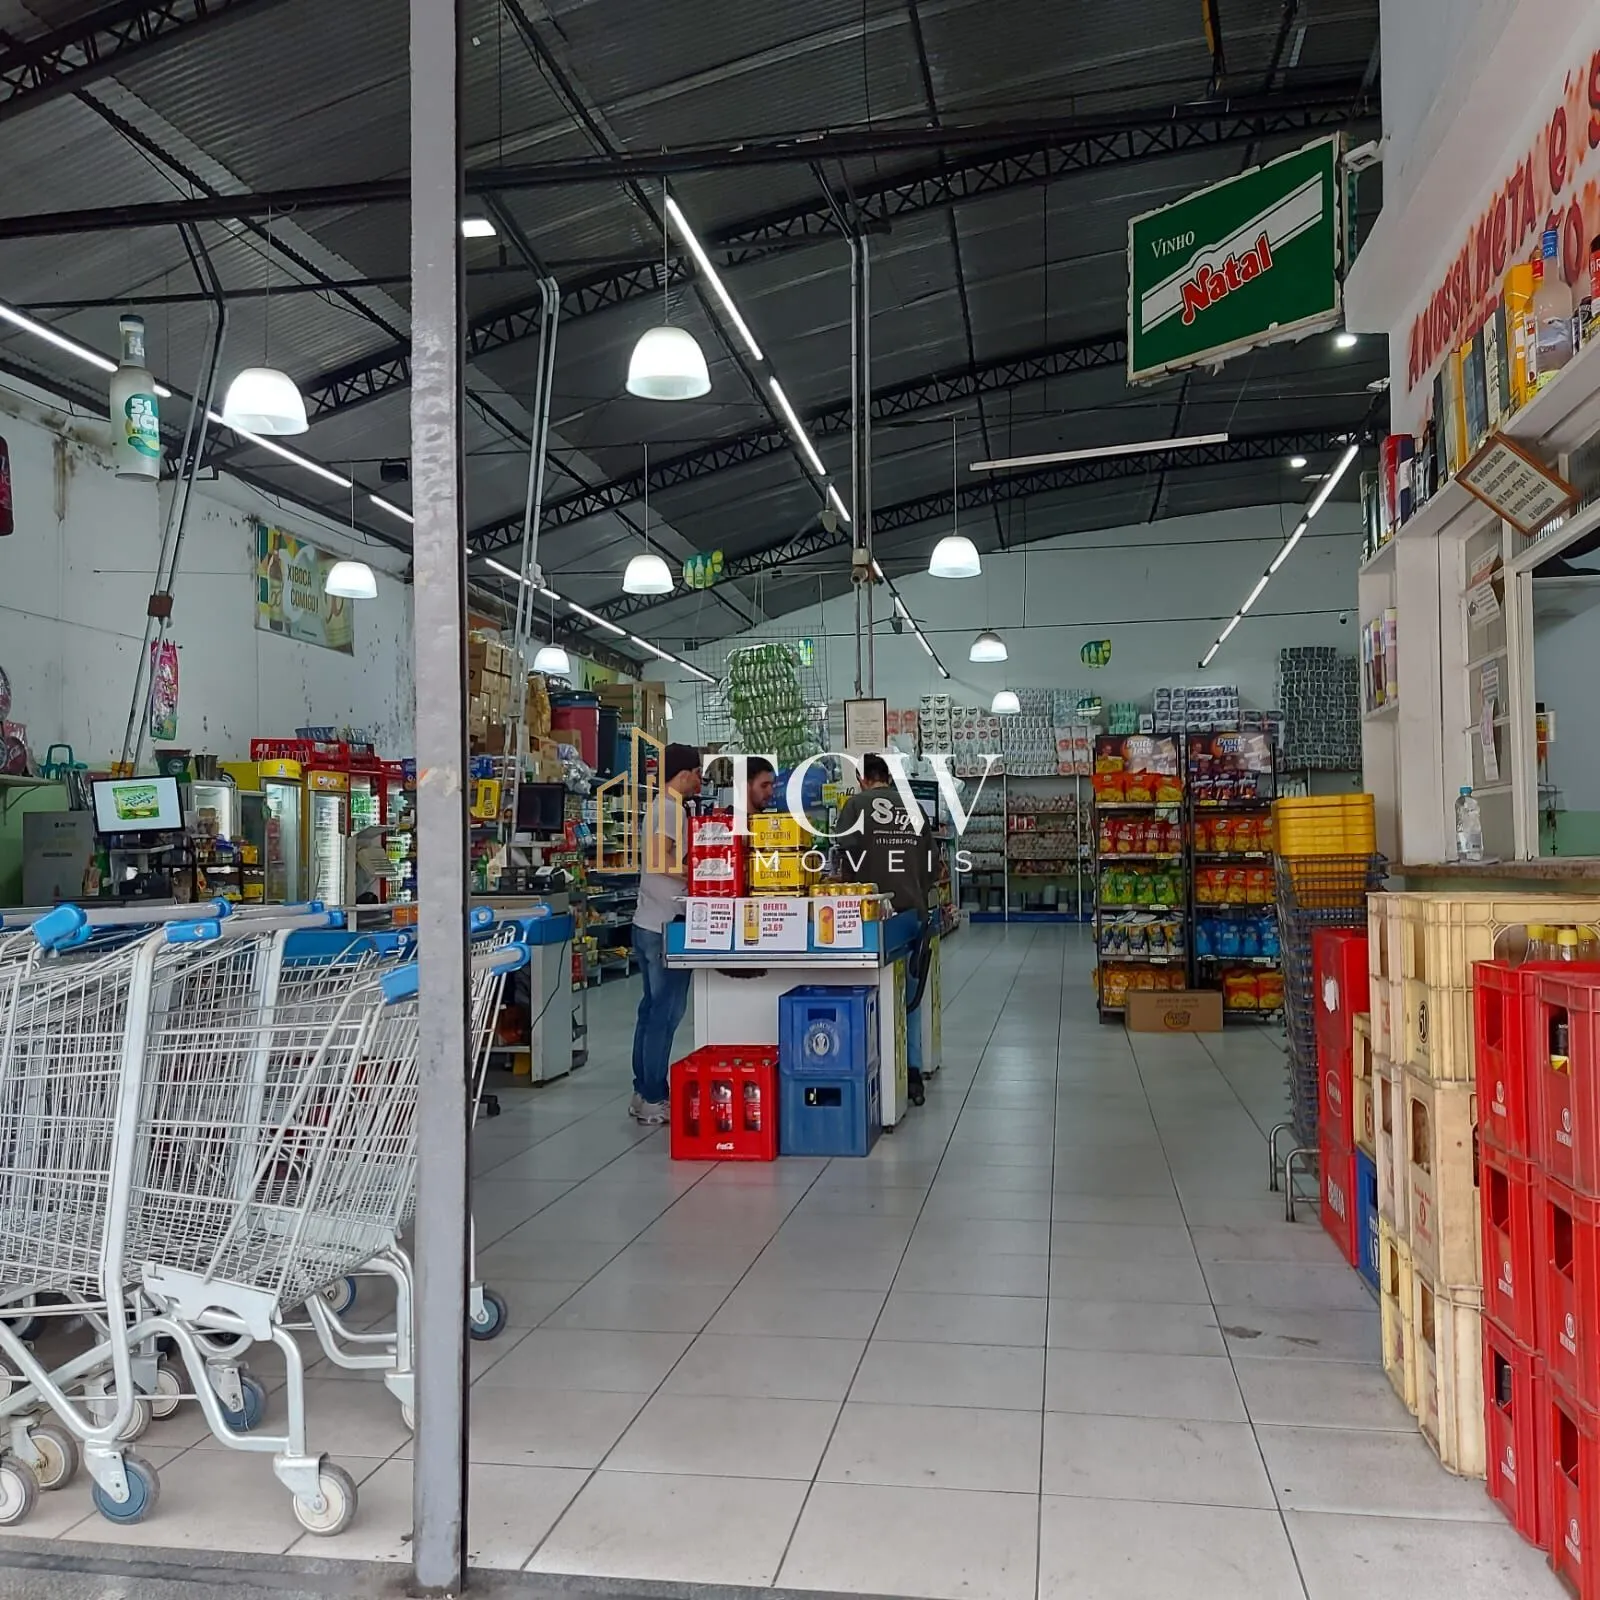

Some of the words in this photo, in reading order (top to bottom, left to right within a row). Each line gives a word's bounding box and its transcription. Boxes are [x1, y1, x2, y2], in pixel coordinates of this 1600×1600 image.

[1151, 230, 1195, 259] VINHO
[1180, 229, 1273, 326] Natal
[131, 398, 153, 415] 51
[290, 589, 319, 614] COMIGO!
[763, 903, 788, 911] OFERTA
